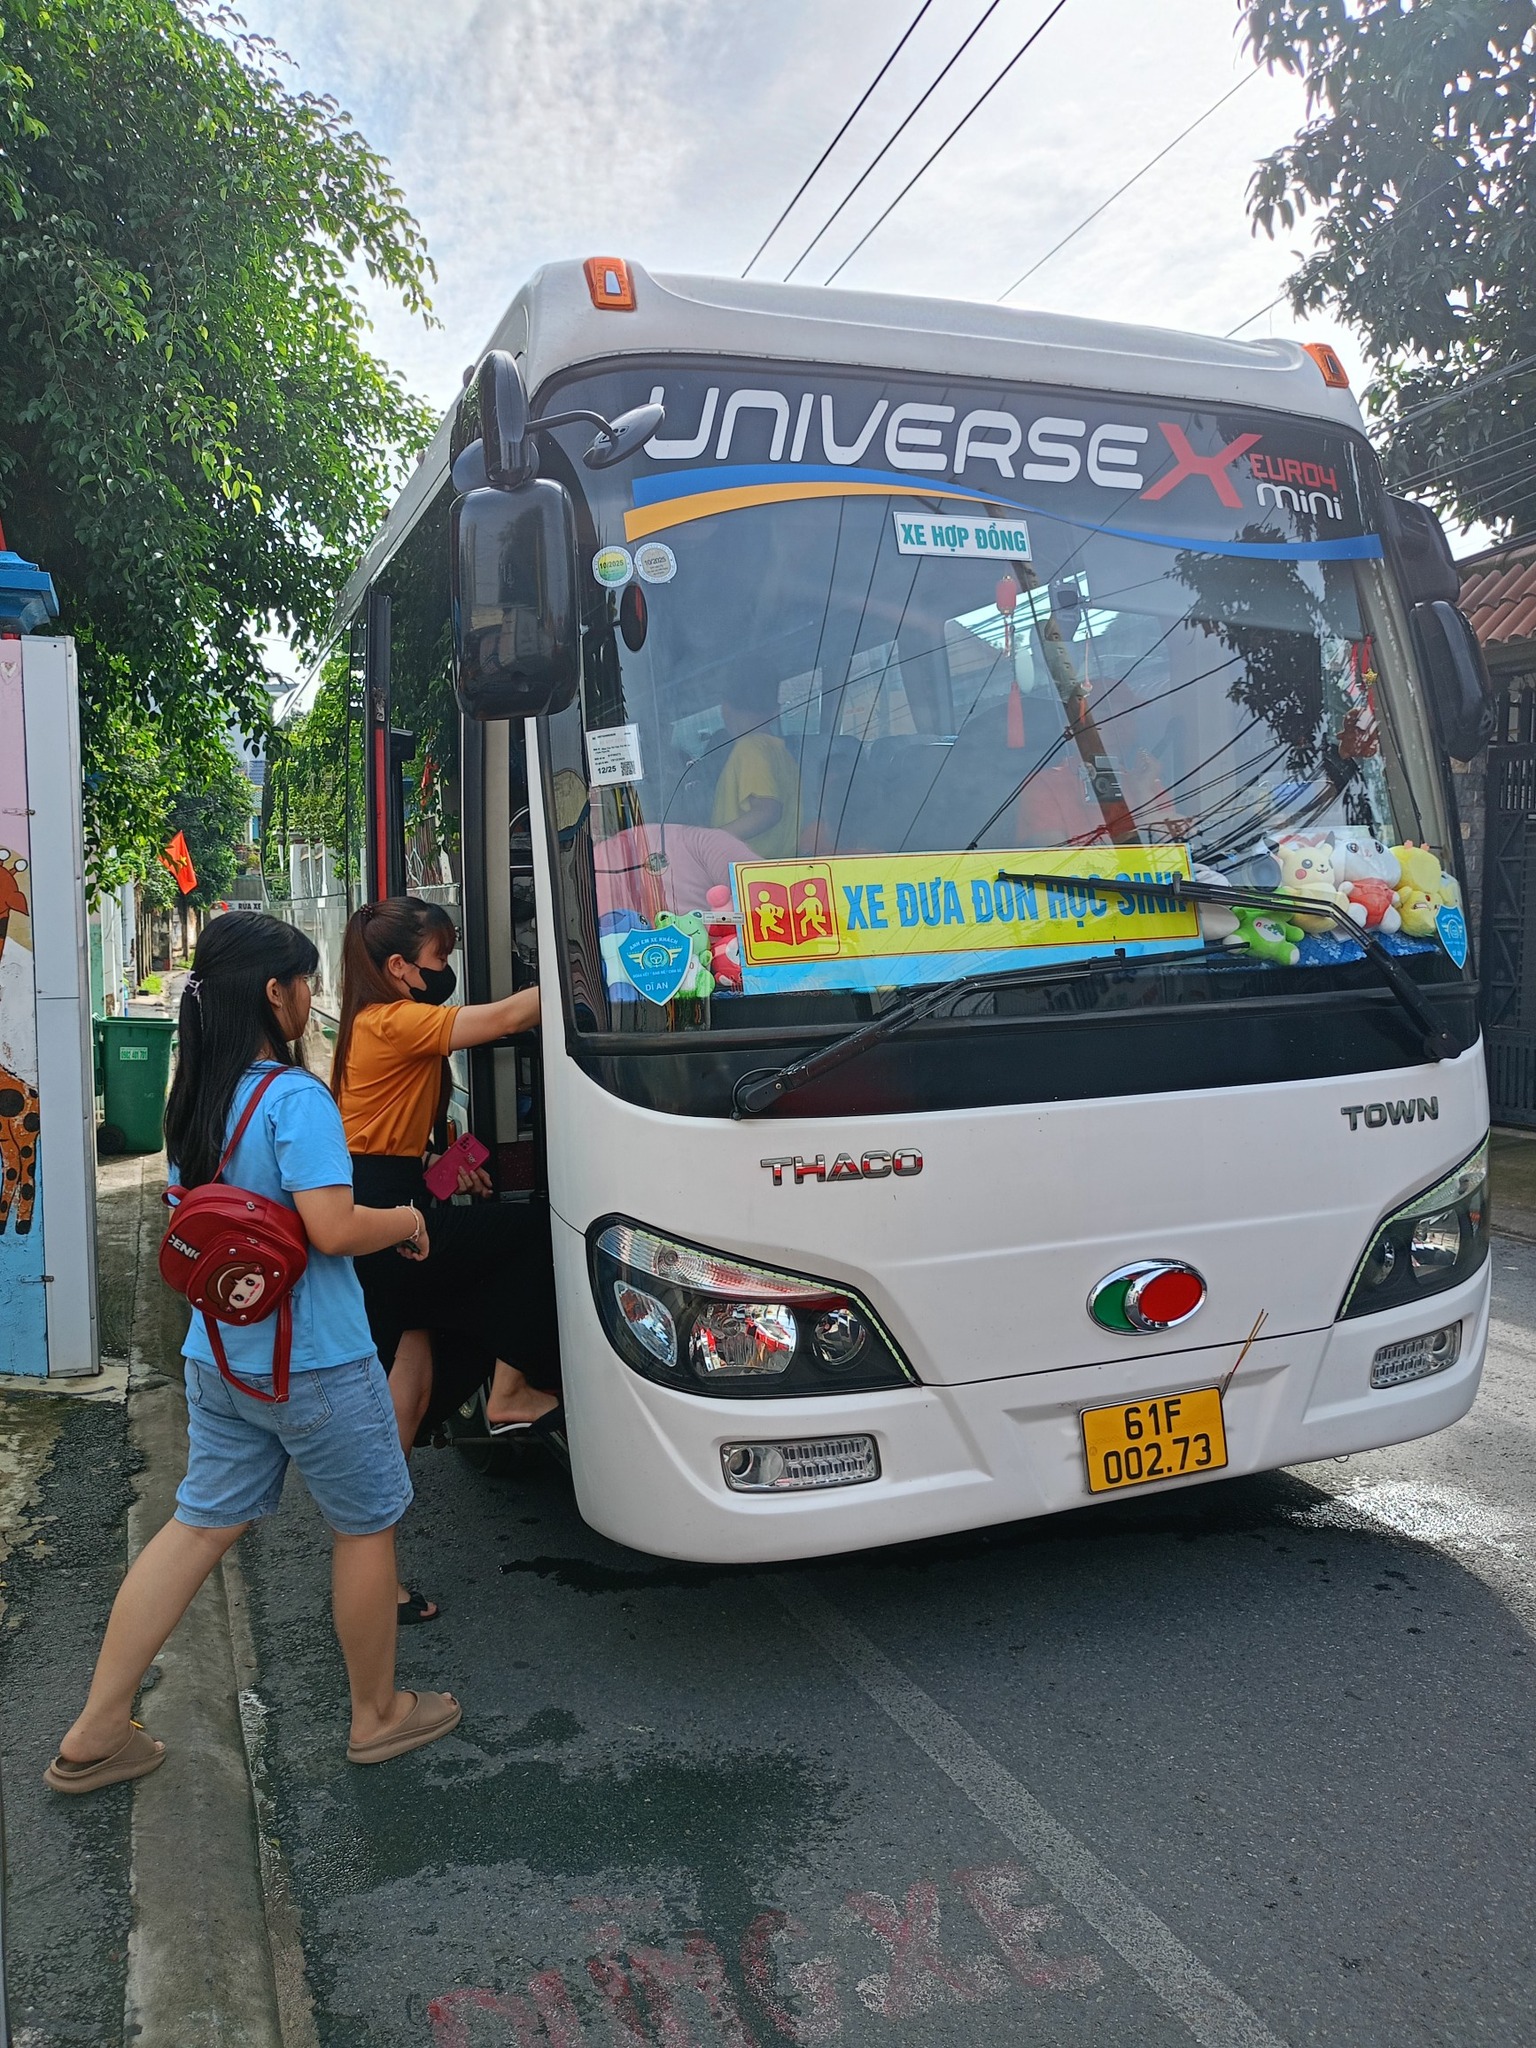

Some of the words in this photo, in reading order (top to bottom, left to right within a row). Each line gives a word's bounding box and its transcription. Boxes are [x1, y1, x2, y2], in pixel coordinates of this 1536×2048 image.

[643, 386, 1149, 490] UNIVERSE
[1139, 422, 1263, 510] X
[1249, 453, 1338, 493] EURO4
[1256, 482, 1343, 520] mini
[900, 523, 927, 546] XE
[931, 524, 969, 553] HỢP
[974, 522, 1027, 552] ĐỒNG
[599, 559, 624, 569] 10/2025
[644, 556, 667, 566] 10/2025
[597, 765, 617, 774] 12/25
[842, 883, 889, 931] XE
[895, 875, 964, 928] ĐƯA
[1046, 873, 1107, 928] HỌC
[656, 982, 668, 990] AN
[1340, 1095, 1440, 1132] TOWN
[759, 1147, 924, 1187] THACO
[1124, 1397, 1182, 1442] 61F
[1103, 1433, 1213, 1486] 002.73
